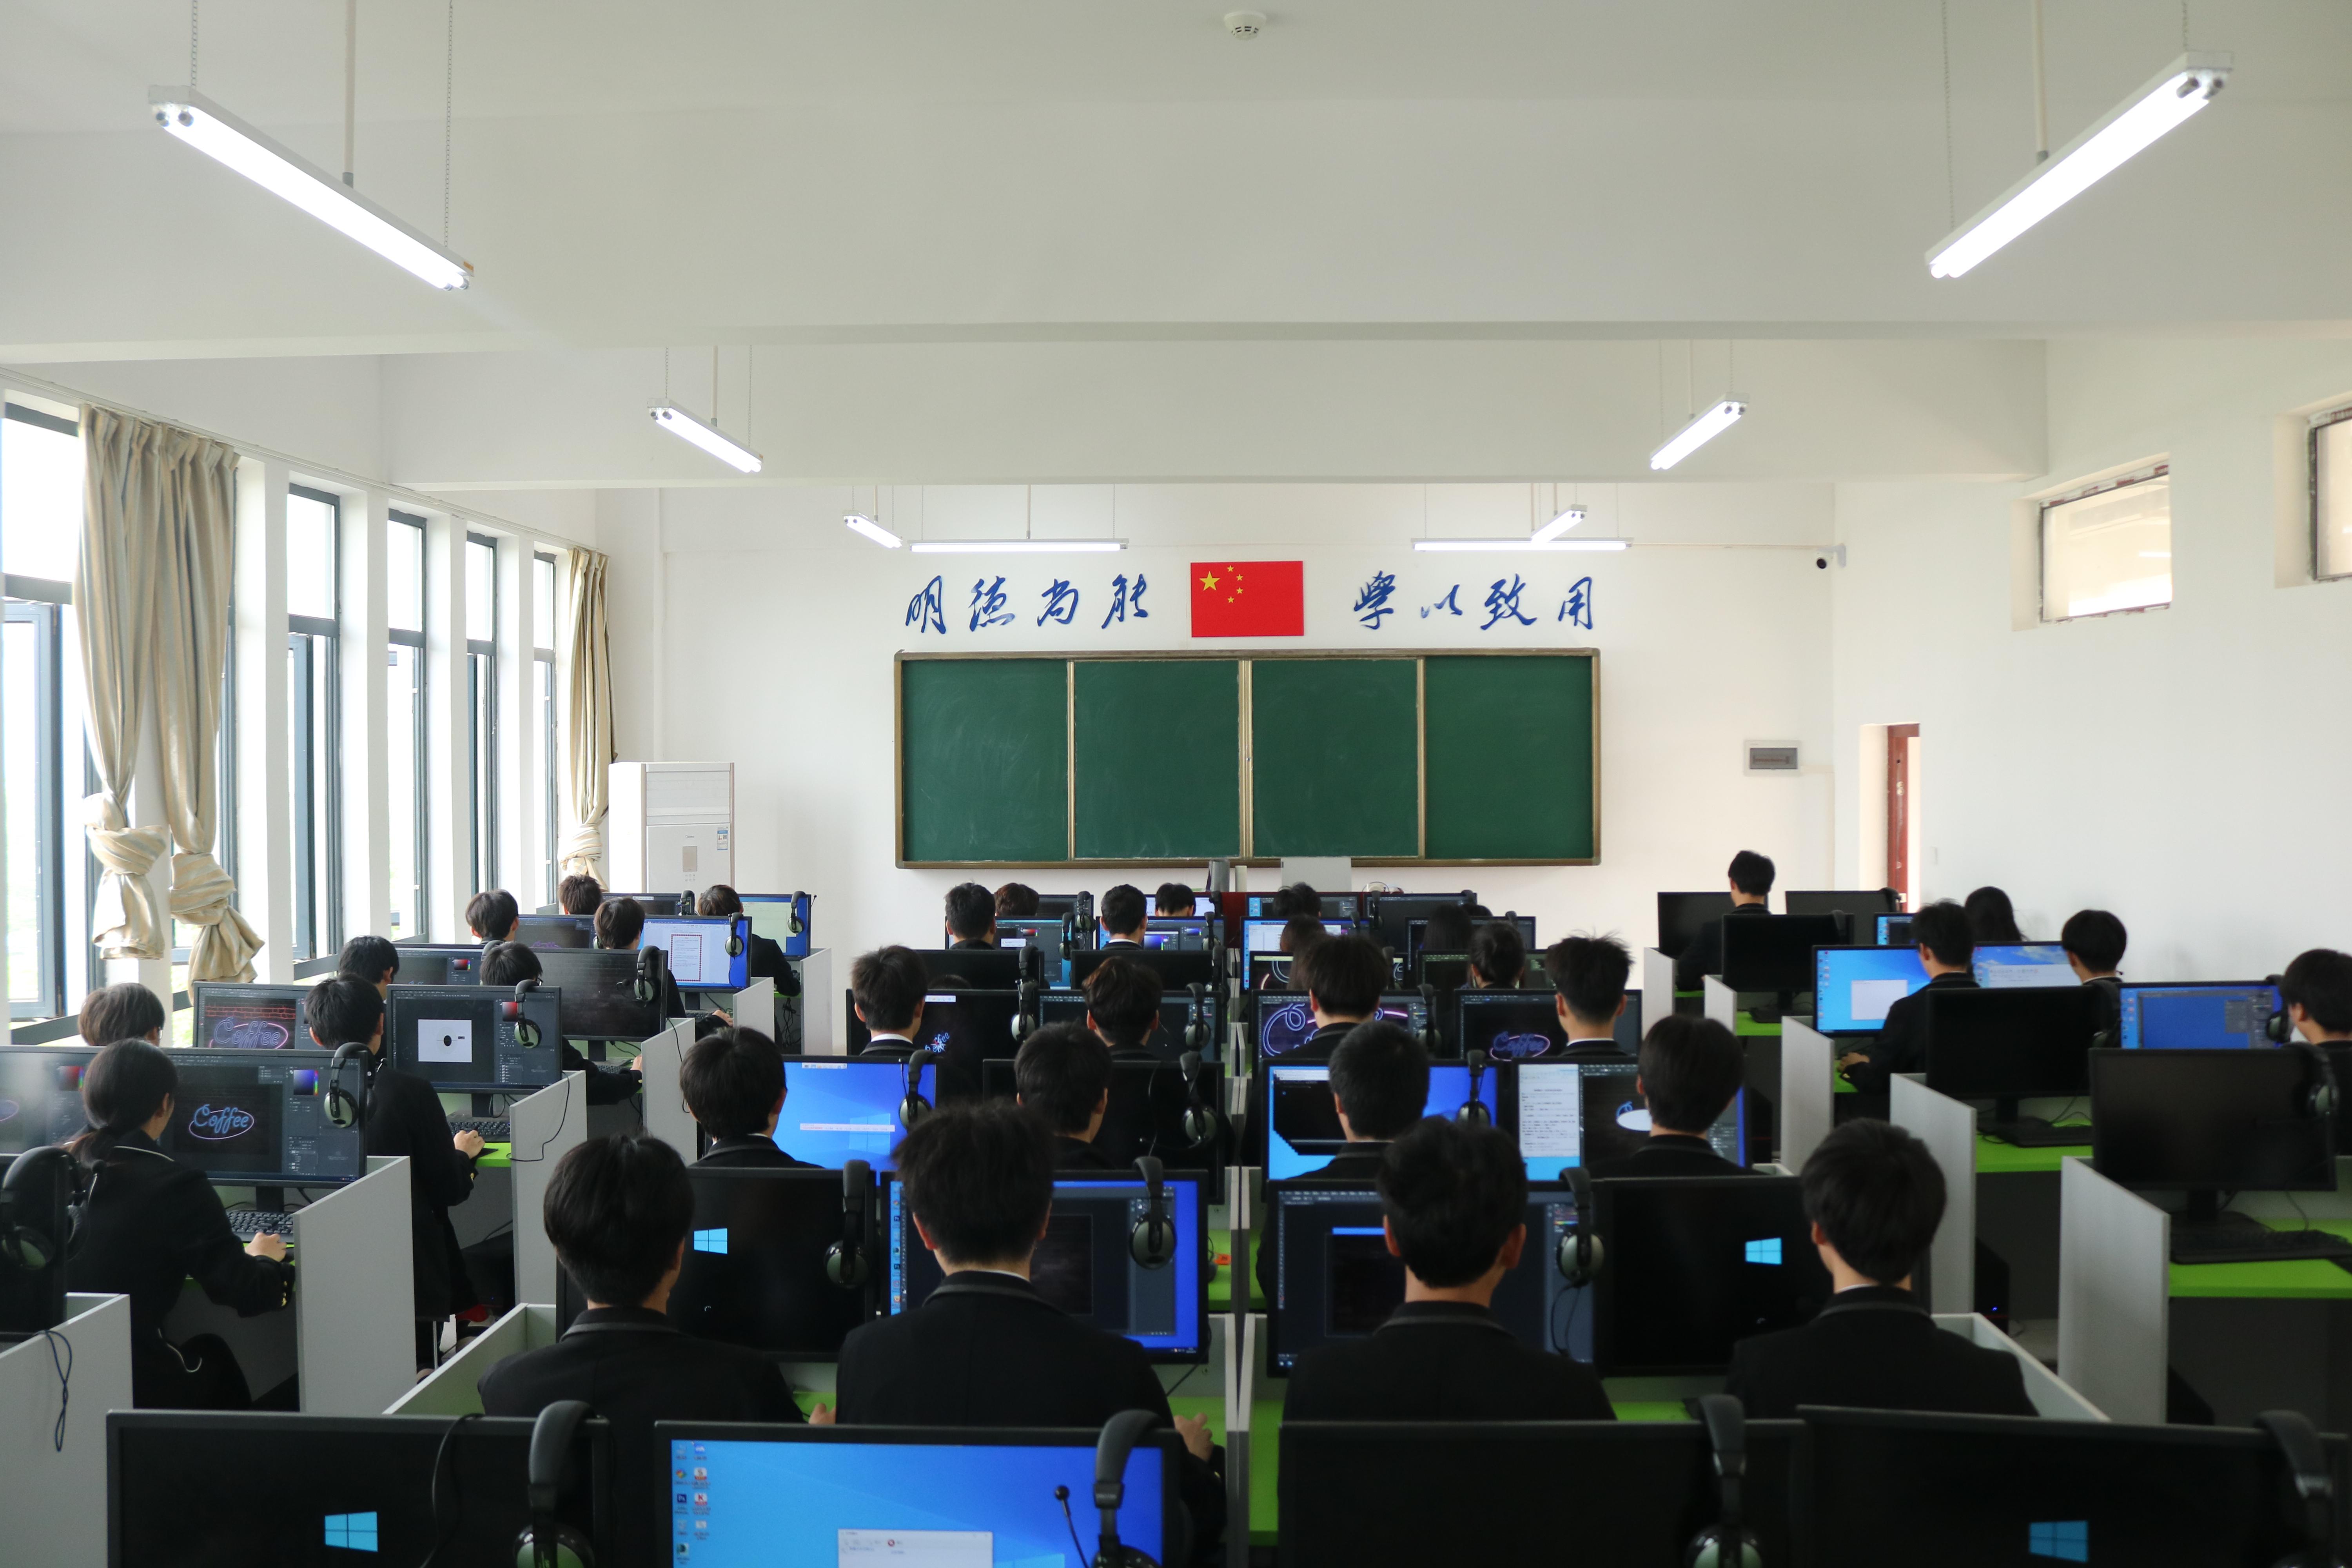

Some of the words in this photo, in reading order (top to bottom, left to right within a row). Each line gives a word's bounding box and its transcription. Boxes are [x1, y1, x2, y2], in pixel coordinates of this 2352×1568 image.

[214, 1016, 281, 1048] Coffee
[1493, 1031, 1544, 1057] Coffee
[193, 1103, 249, 1134] Coffee
